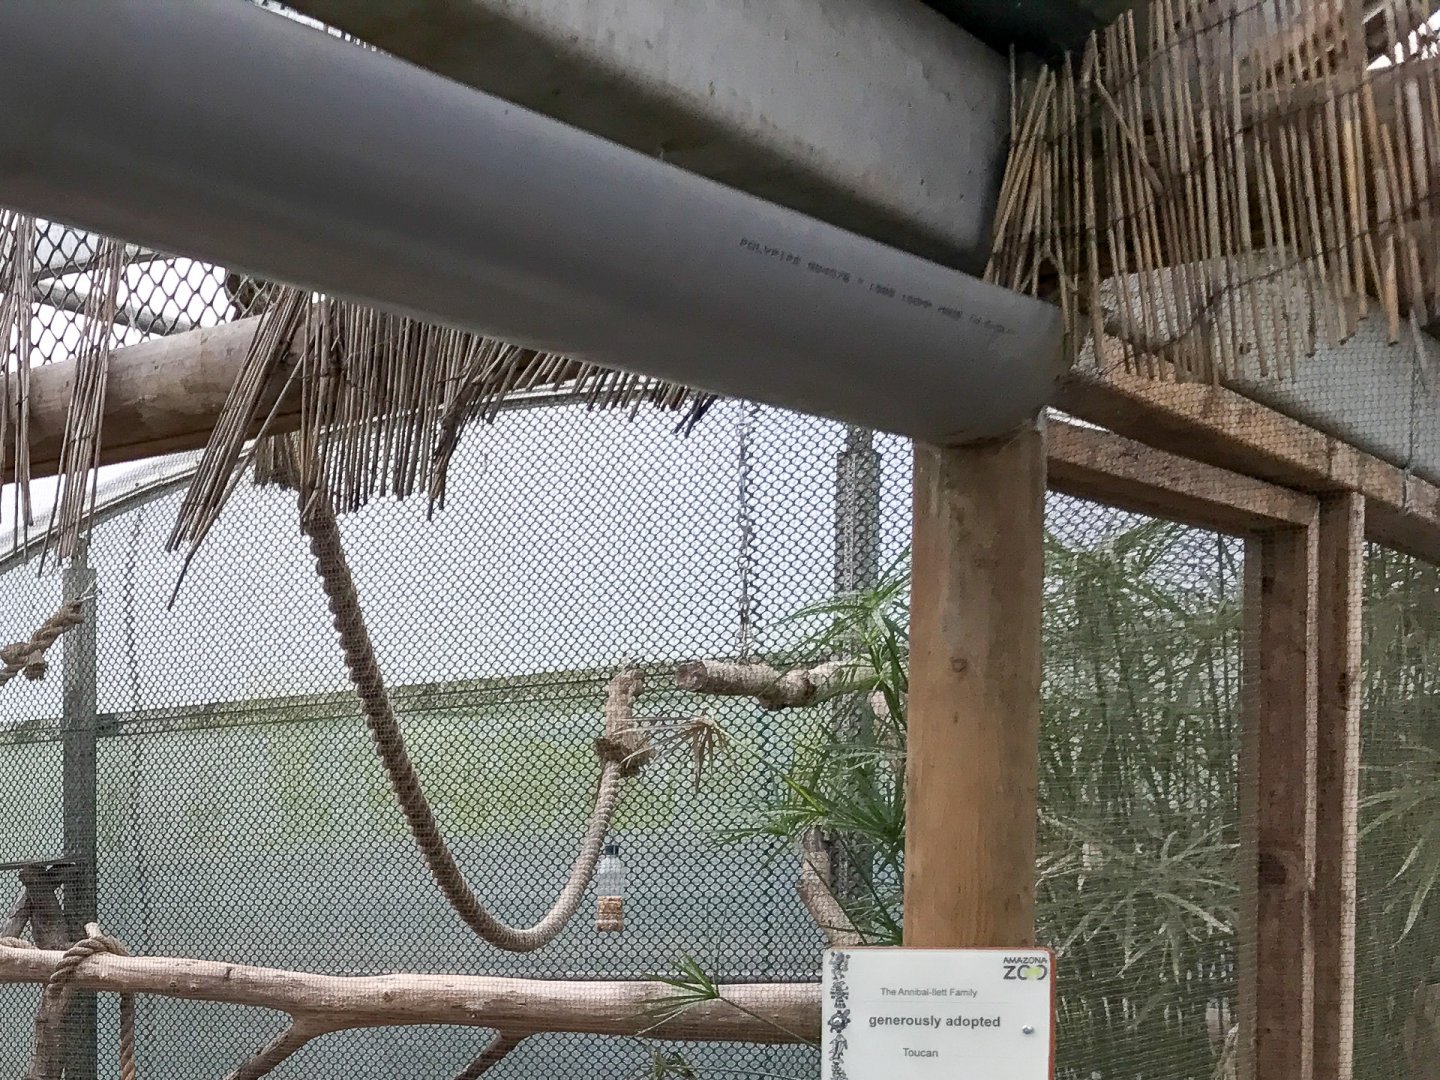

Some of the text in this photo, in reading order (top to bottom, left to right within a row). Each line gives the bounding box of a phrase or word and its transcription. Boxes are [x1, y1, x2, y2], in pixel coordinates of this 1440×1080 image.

[1002, 956, 1047, 964] AMAZONA
[880, 987, 896, 995] The
[948, 988, 977, 999] Family
[868, 1014, 1001, 1029] generously adopted
[902, 1047, 939, 1057] Toucan
